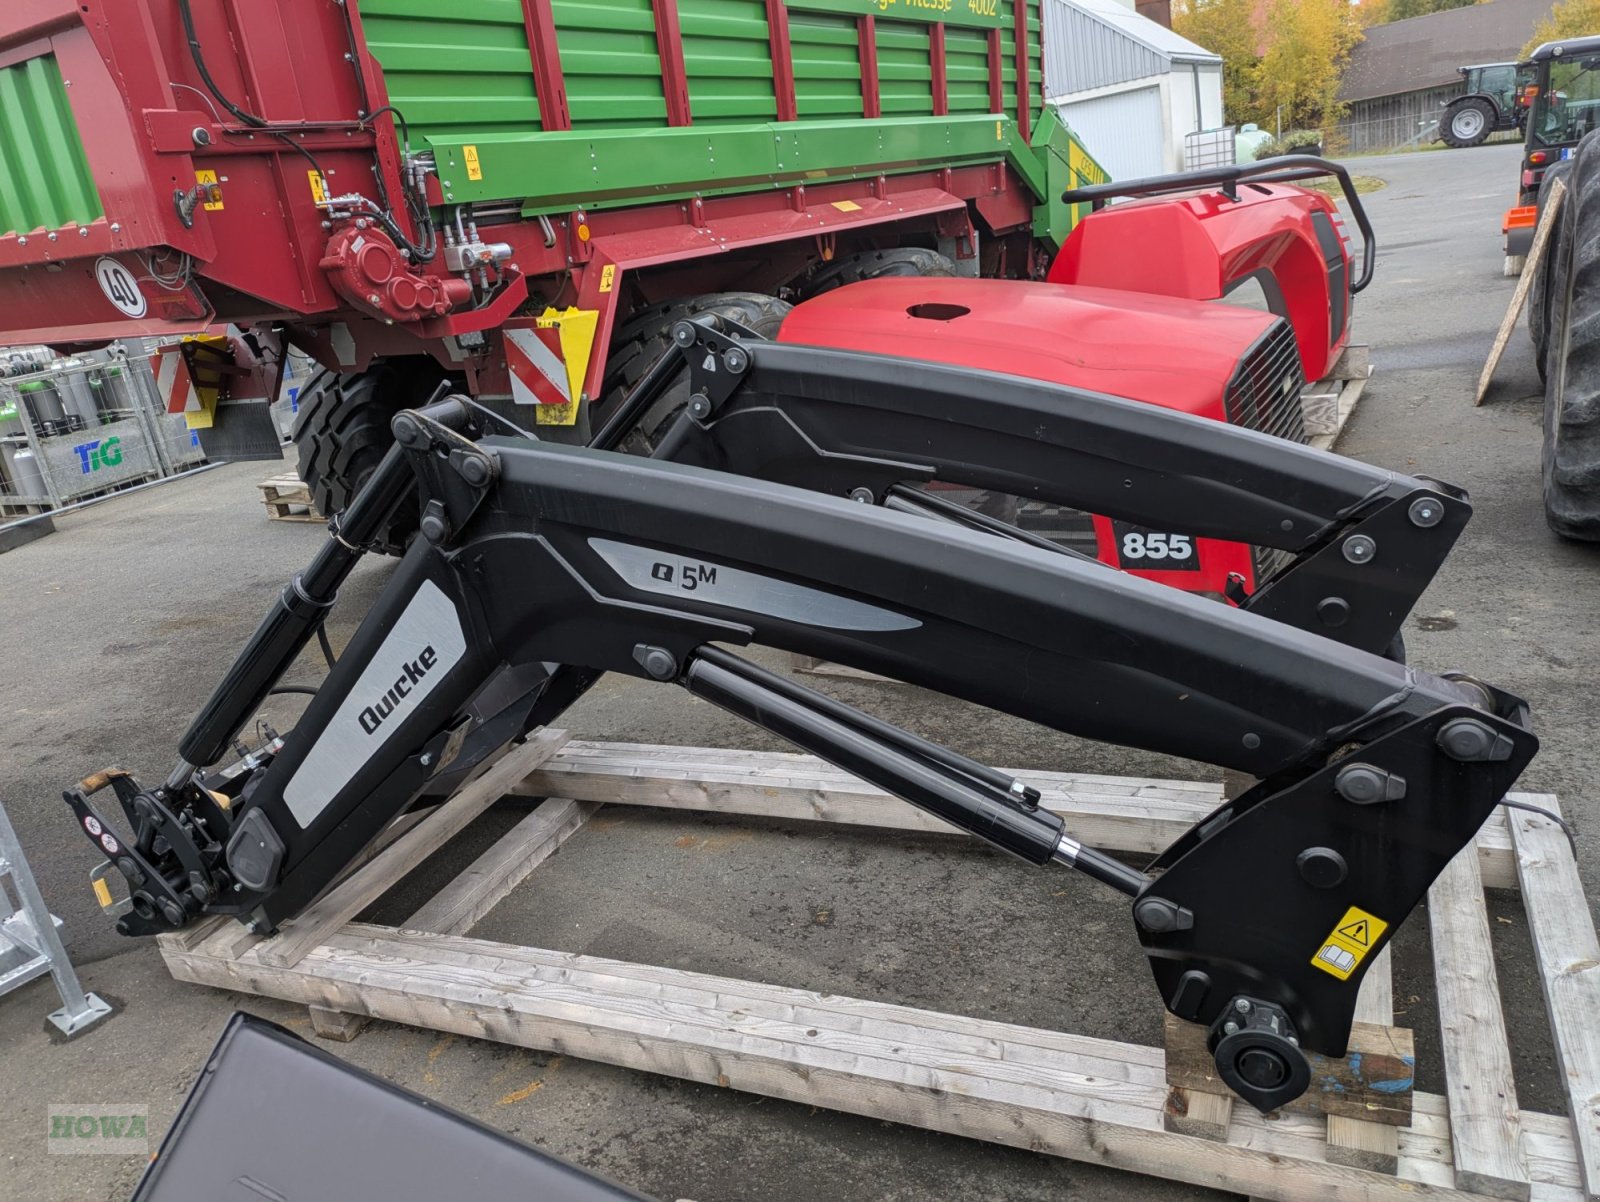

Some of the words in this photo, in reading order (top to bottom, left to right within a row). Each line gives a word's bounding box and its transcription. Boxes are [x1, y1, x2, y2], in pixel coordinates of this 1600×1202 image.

[967, 0, 996, 16] 4002
[103, 267, 138, 307] 40
[1122, 532, 1193, 560] 855
[357, 644, 438, 736] Quicke
